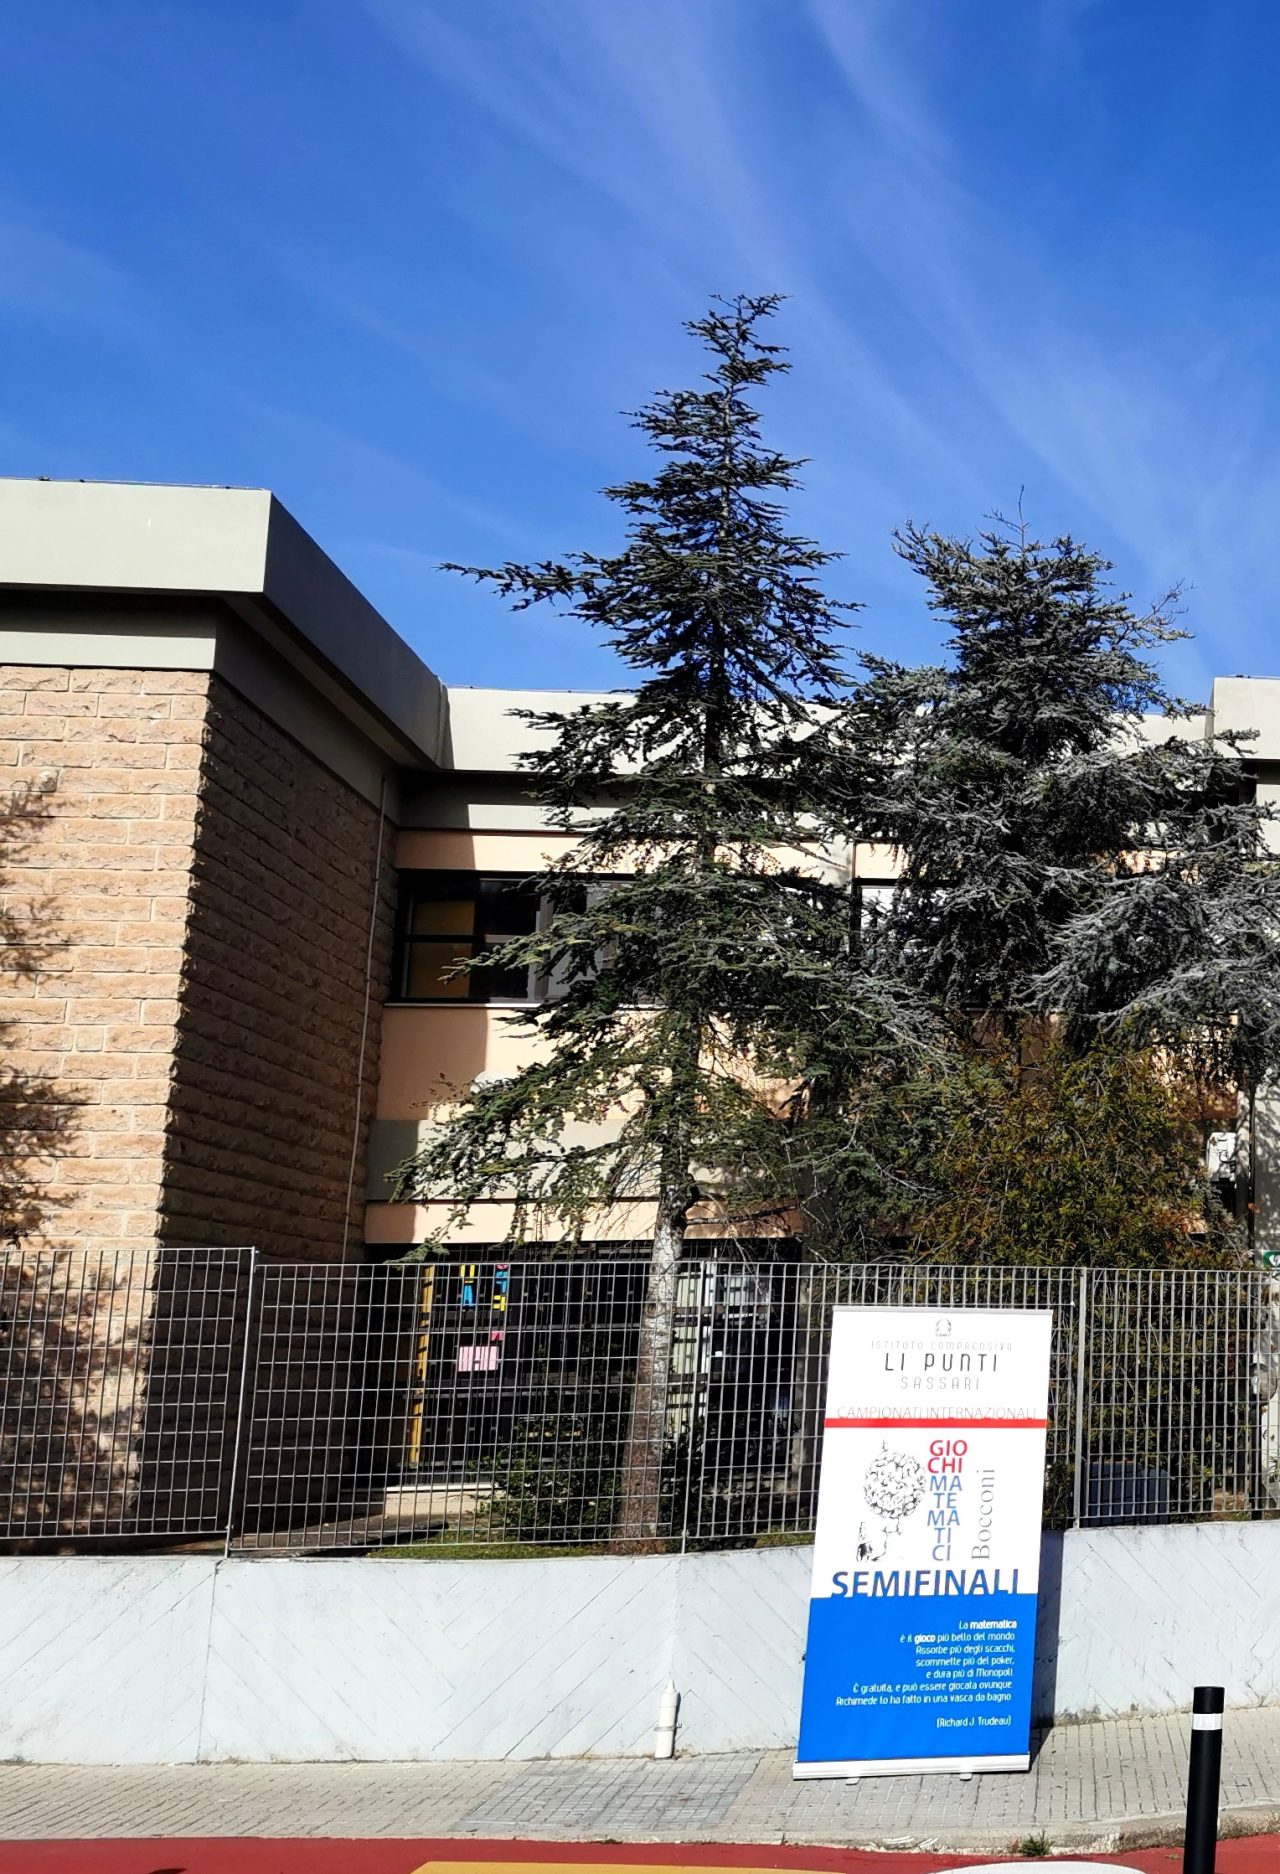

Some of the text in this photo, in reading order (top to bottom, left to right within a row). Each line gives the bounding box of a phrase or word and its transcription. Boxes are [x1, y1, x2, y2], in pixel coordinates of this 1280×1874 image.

[885, 1353, 997, 1372] LI PUNTI
[901, 1376, 980, 1390] SASSARI
[837, 1406, 1036, 1420] CAMPIONATI INTERNAZIONALI
[929, 1439, 968, 1457] GIO
[927, 1457, 963, 1474] CHI
[929, 1475, 962, 1492] MA
[933, 1492, 957, 1509] TE
[927, 1509, 960, 1526] MA
[971, 1469, 995, 1560] Bocconi
[934, 1527, 952, 1544] TI
[932, 1544, 951, 1562] CI
[831, 1569, 1019, 1599] SEMIFINALI
[959, 1620, 1017, 1630] La matematica
[914, 1634, 936, 1645] gioco
[937, 1633, 949, 1644] più
[951, 1633, 971, 1642] bello
[973, 1632, 985, 1641] del
[987, 1632, 1015, 1641] mondo
[916, 1645, 948, 1654] Assorbe
[949, 1644, 961, 1655] più
[963, 1643, 983, 1655] degli
[916, 1655, 1015, 1667] scommette più del poker,
[926, 1667, 1013, 1680] e dura più di Monopoli
[895, 1684, 900, 1692] e
[902, 1683, 918, 1693] può
[920, 1682, 947, 1691] essere
[948, 1680, 977, 1692] giocata
[979, 1680, 1012, 1690] ovunque
[836, 1691, 1012, 1706] Archimede lo ha fatto in una vasca da bagno
[936, 1716, 968, 1729] (Richard
[977, 1714, 1012, 1726] Trudeau)
